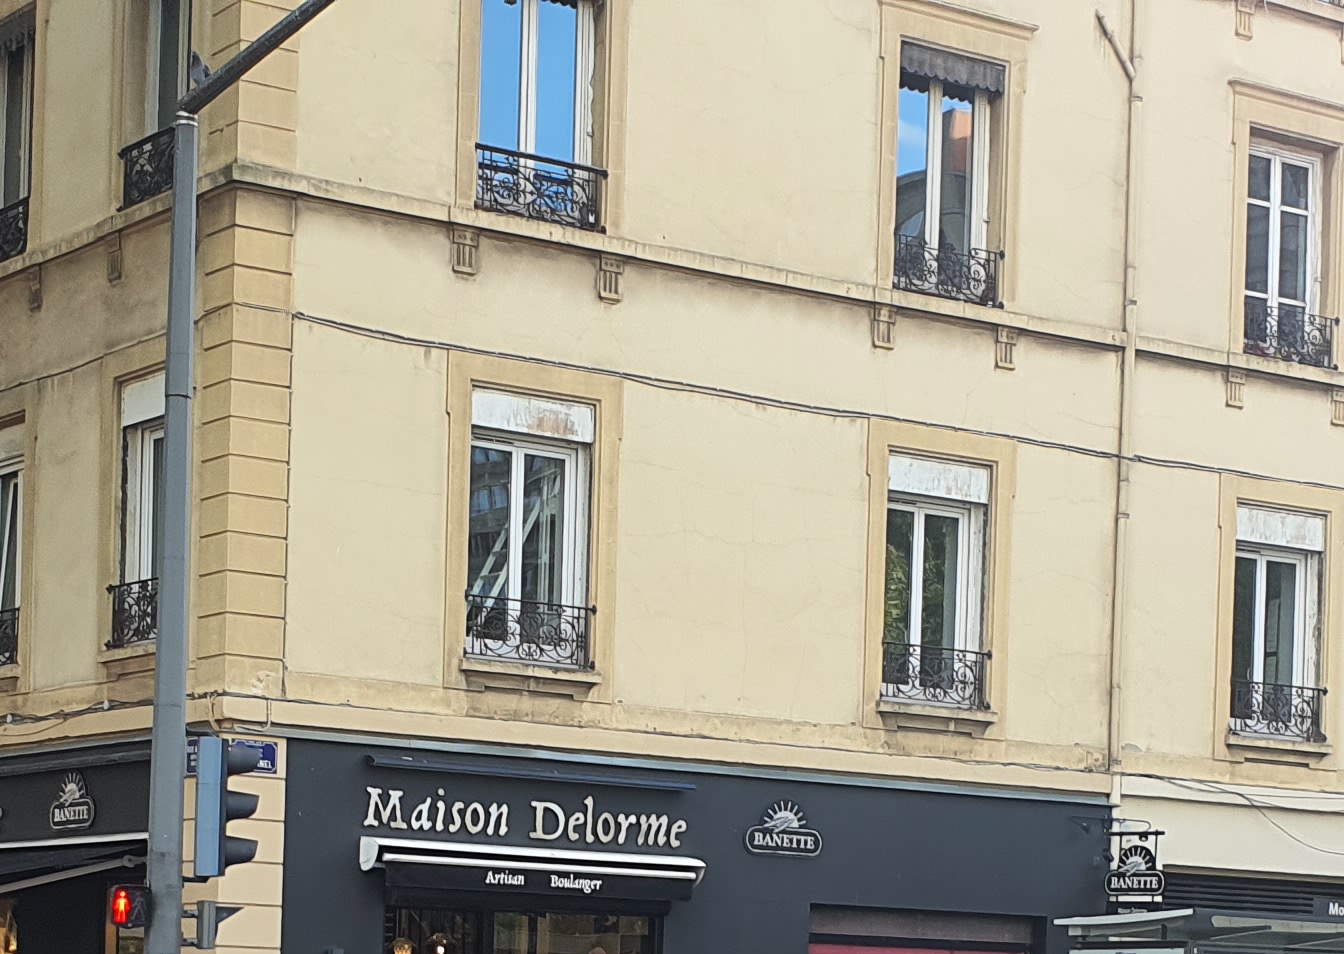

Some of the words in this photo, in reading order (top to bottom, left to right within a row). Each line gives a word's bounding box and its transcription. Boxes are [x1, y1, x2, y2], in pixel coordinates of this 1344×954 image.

[53, 805, 89, 822] BANETTE
[363, 786, 509, 838] Maison
[529, 796, 688, 848] Delorme
[753, 831, 815, 850] BANETTE
[485, 870, 525, 886] Artisan
[550, 873, 602, 893] Boulanger
[1110, 876, 1159, 889] BANETTE
